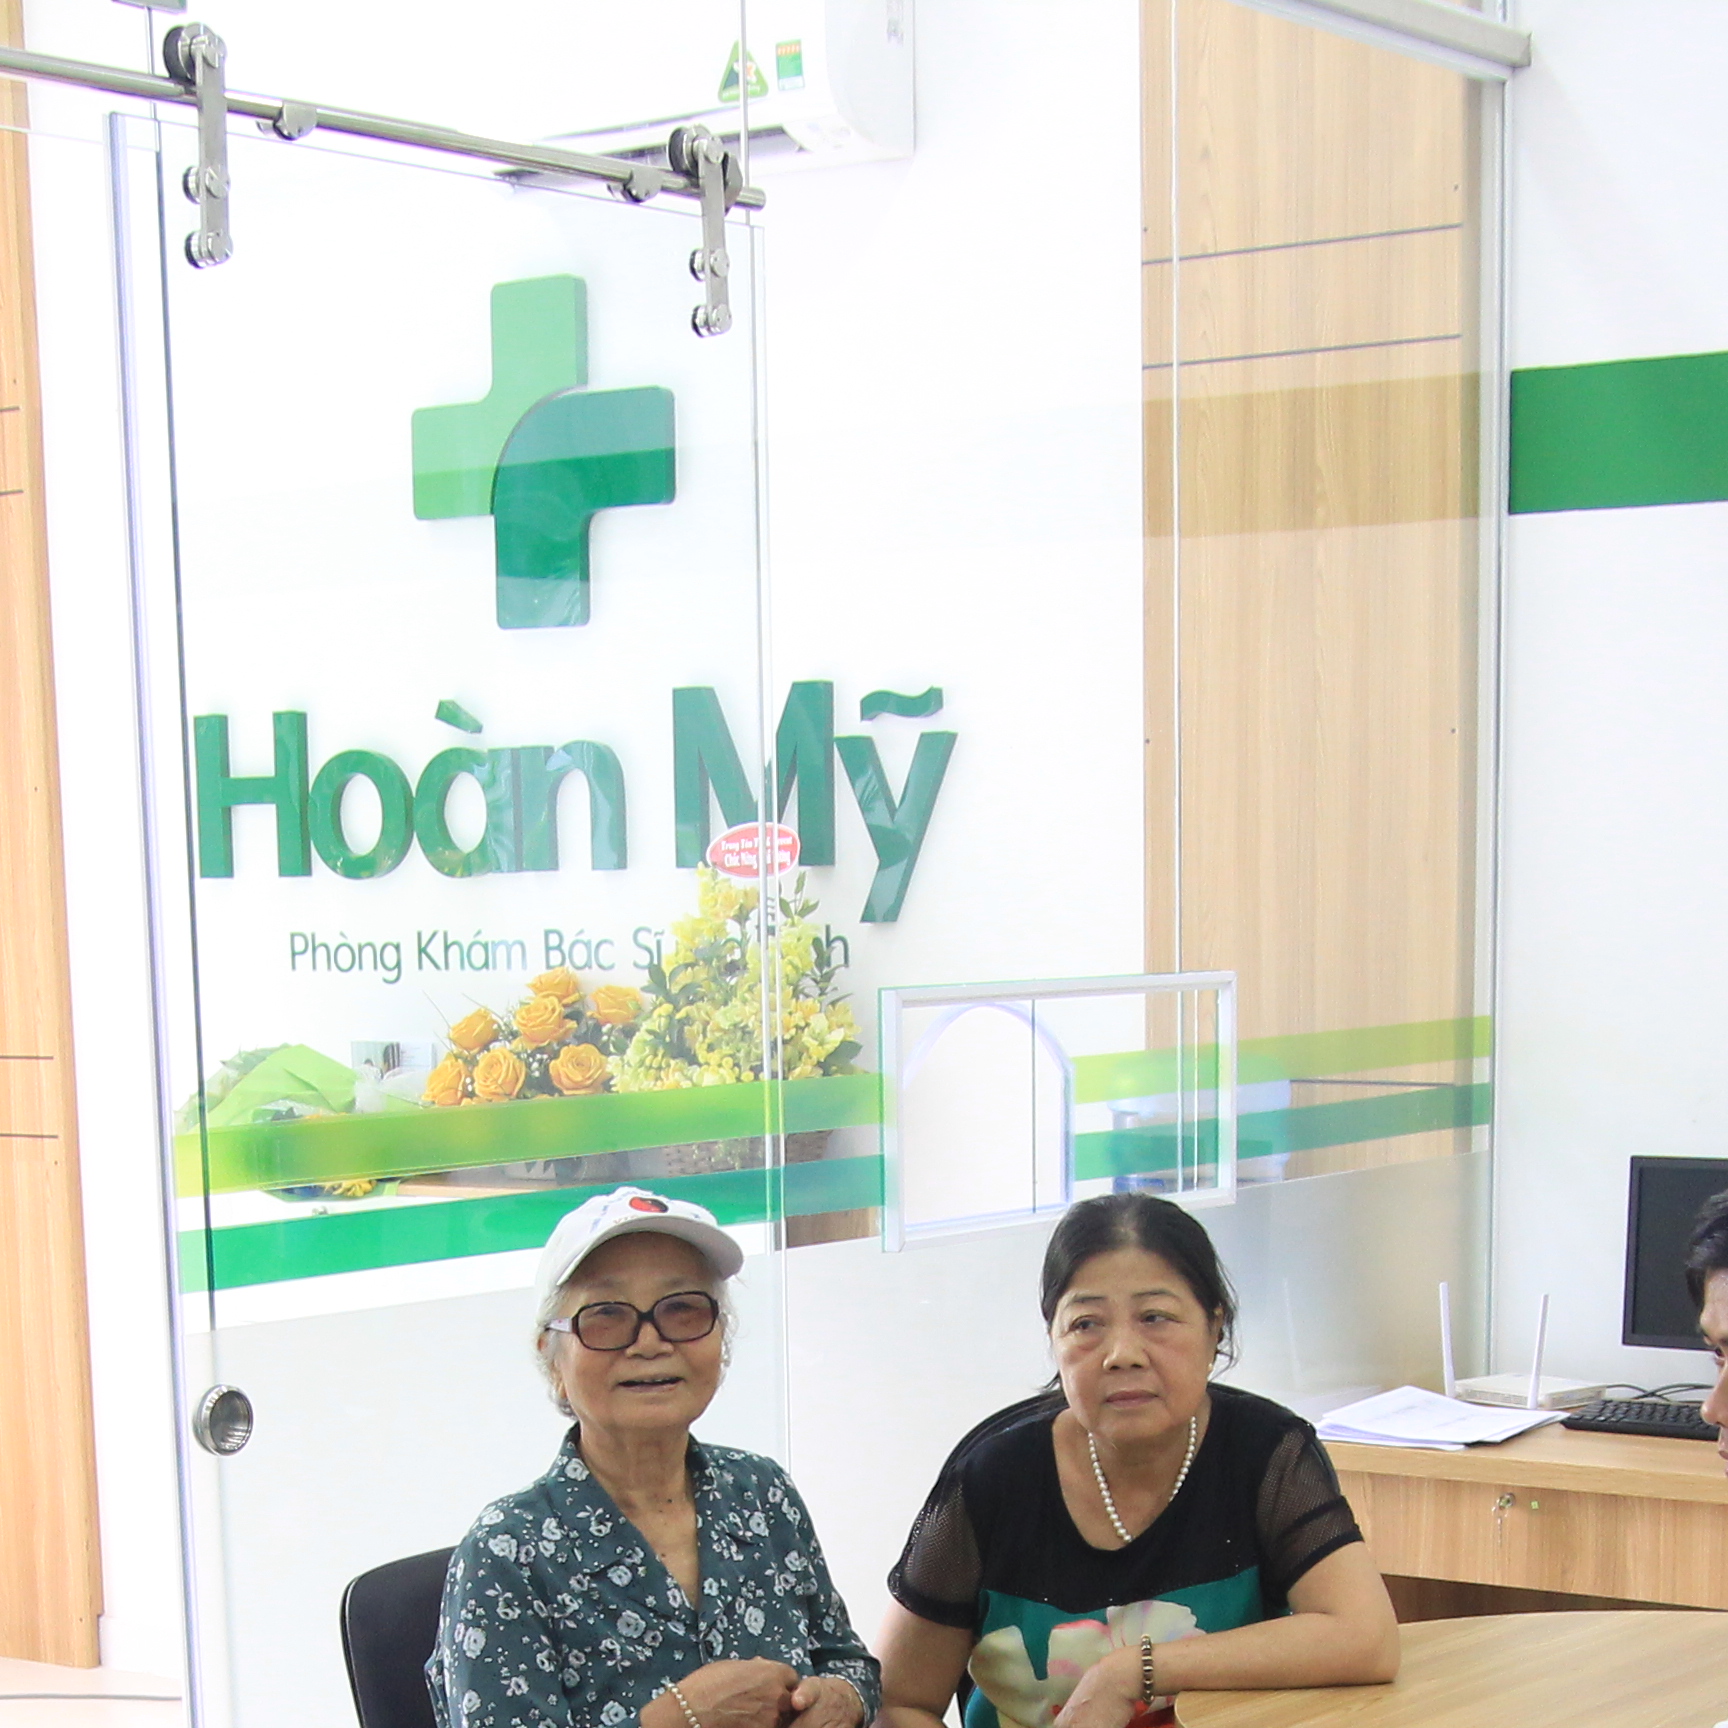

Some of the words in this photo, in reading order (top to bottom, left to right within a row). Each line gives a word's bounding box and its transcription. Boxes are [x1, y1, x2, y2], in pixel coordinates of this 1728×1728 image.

[193, 699, 627, 879] Hoàn
[672, 680, 958, 923] Mỹ
[289, 930, 401, 984] Phòng
[417, 926, 528, 971] Khám
[544, 927, 615, 971] Bác
[632, 925, 663, 970] Sĩ
